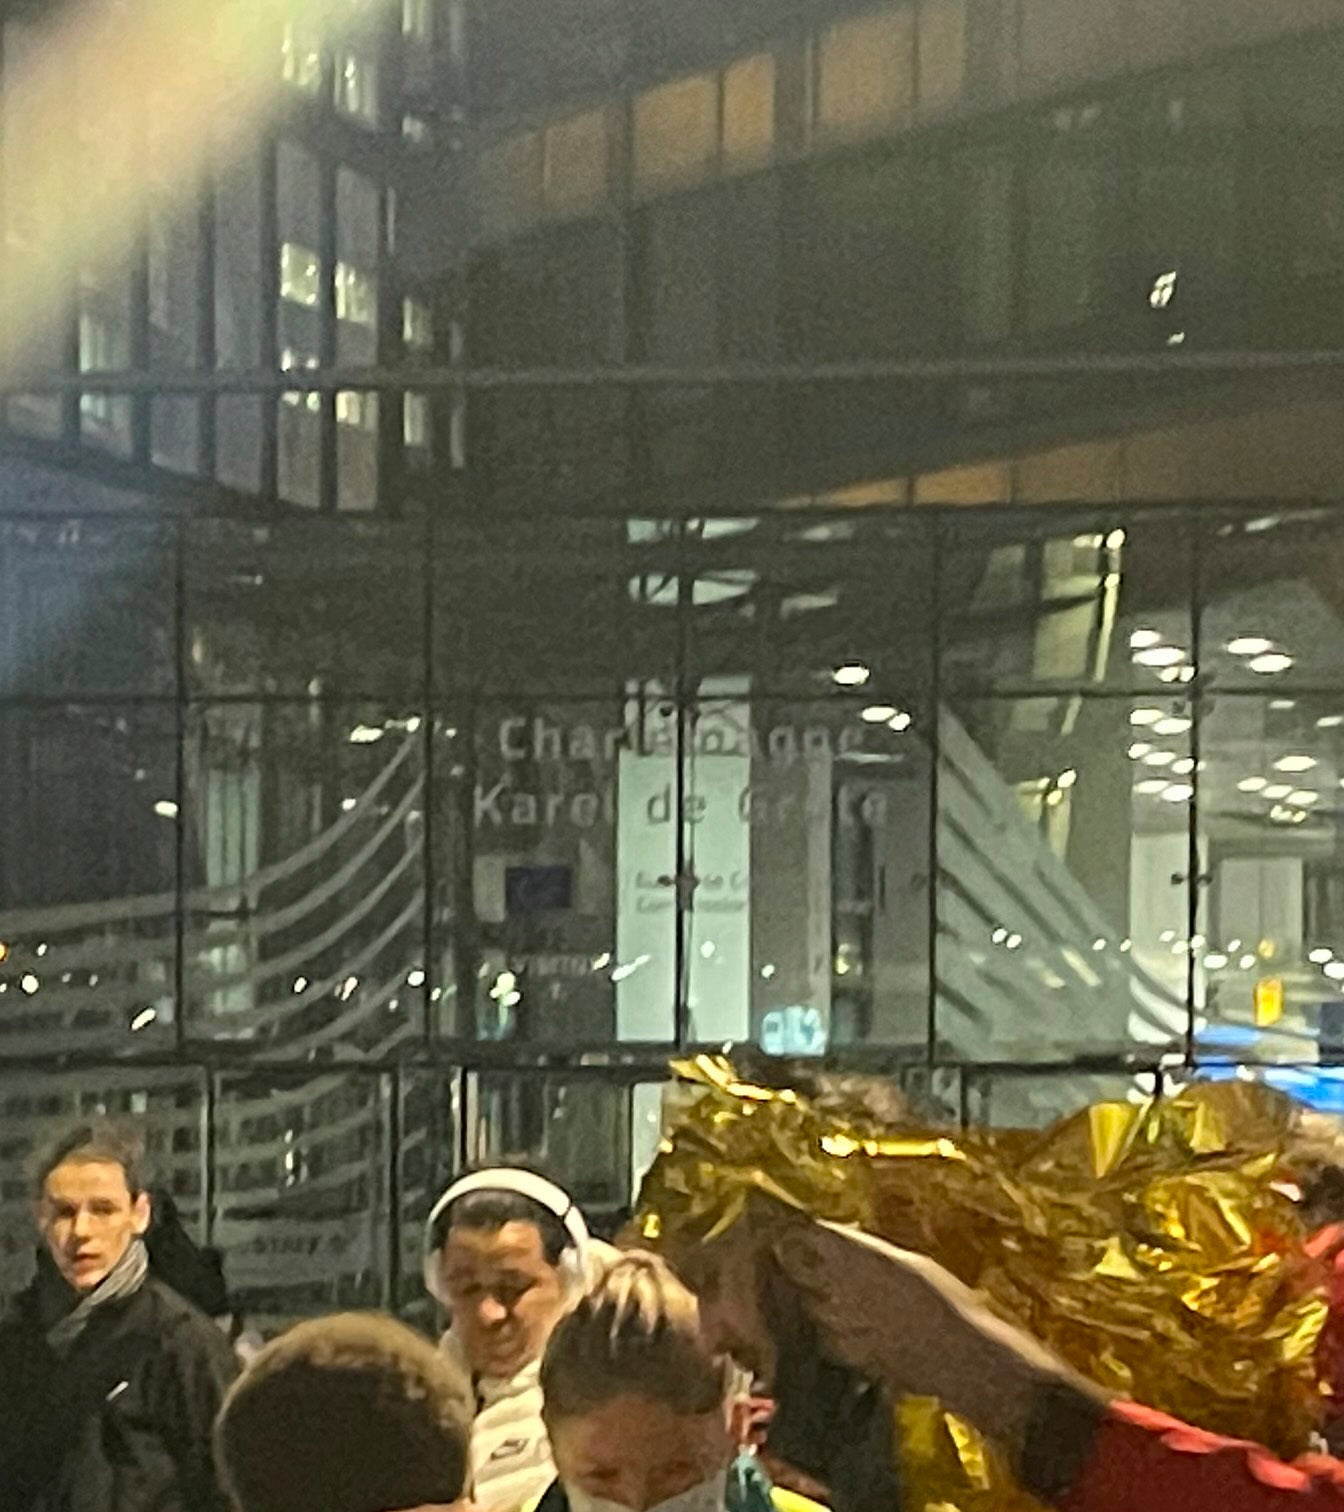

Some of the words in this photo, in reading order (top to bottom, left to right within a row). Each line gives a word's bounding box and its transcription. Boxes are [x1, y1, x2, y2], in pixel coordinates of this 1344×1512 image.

[498, 716, 864, 771] Charlegne
[647, 783, 706, 825] de
[739, 782, 888, 827] Grte
